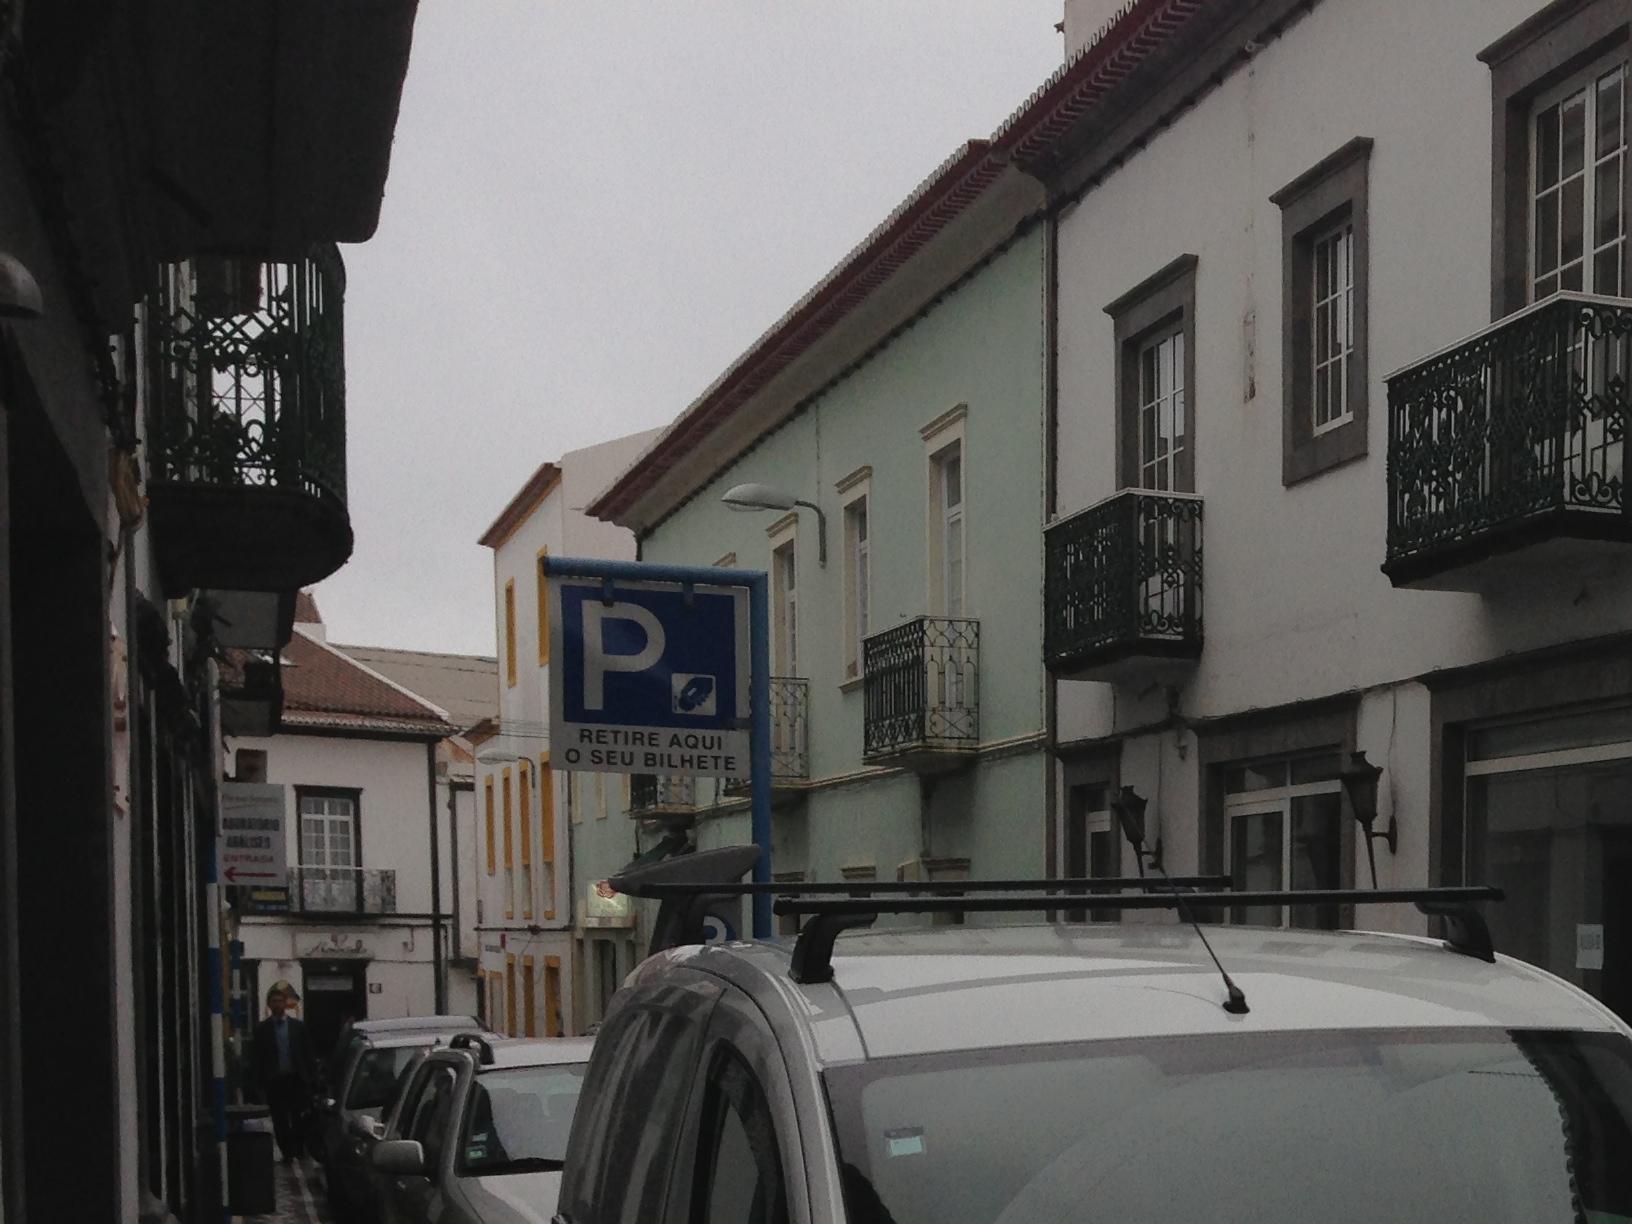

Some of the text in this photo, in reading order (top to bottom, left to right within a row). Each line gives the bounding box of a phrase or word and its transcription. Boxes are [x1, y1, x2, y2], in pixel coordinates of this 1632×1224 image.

[582, 599, 667, 711] P
[579, 728, 723, 751] RETIRE AQUI
[565, 748, 737, 772] O SEU BILHETE
